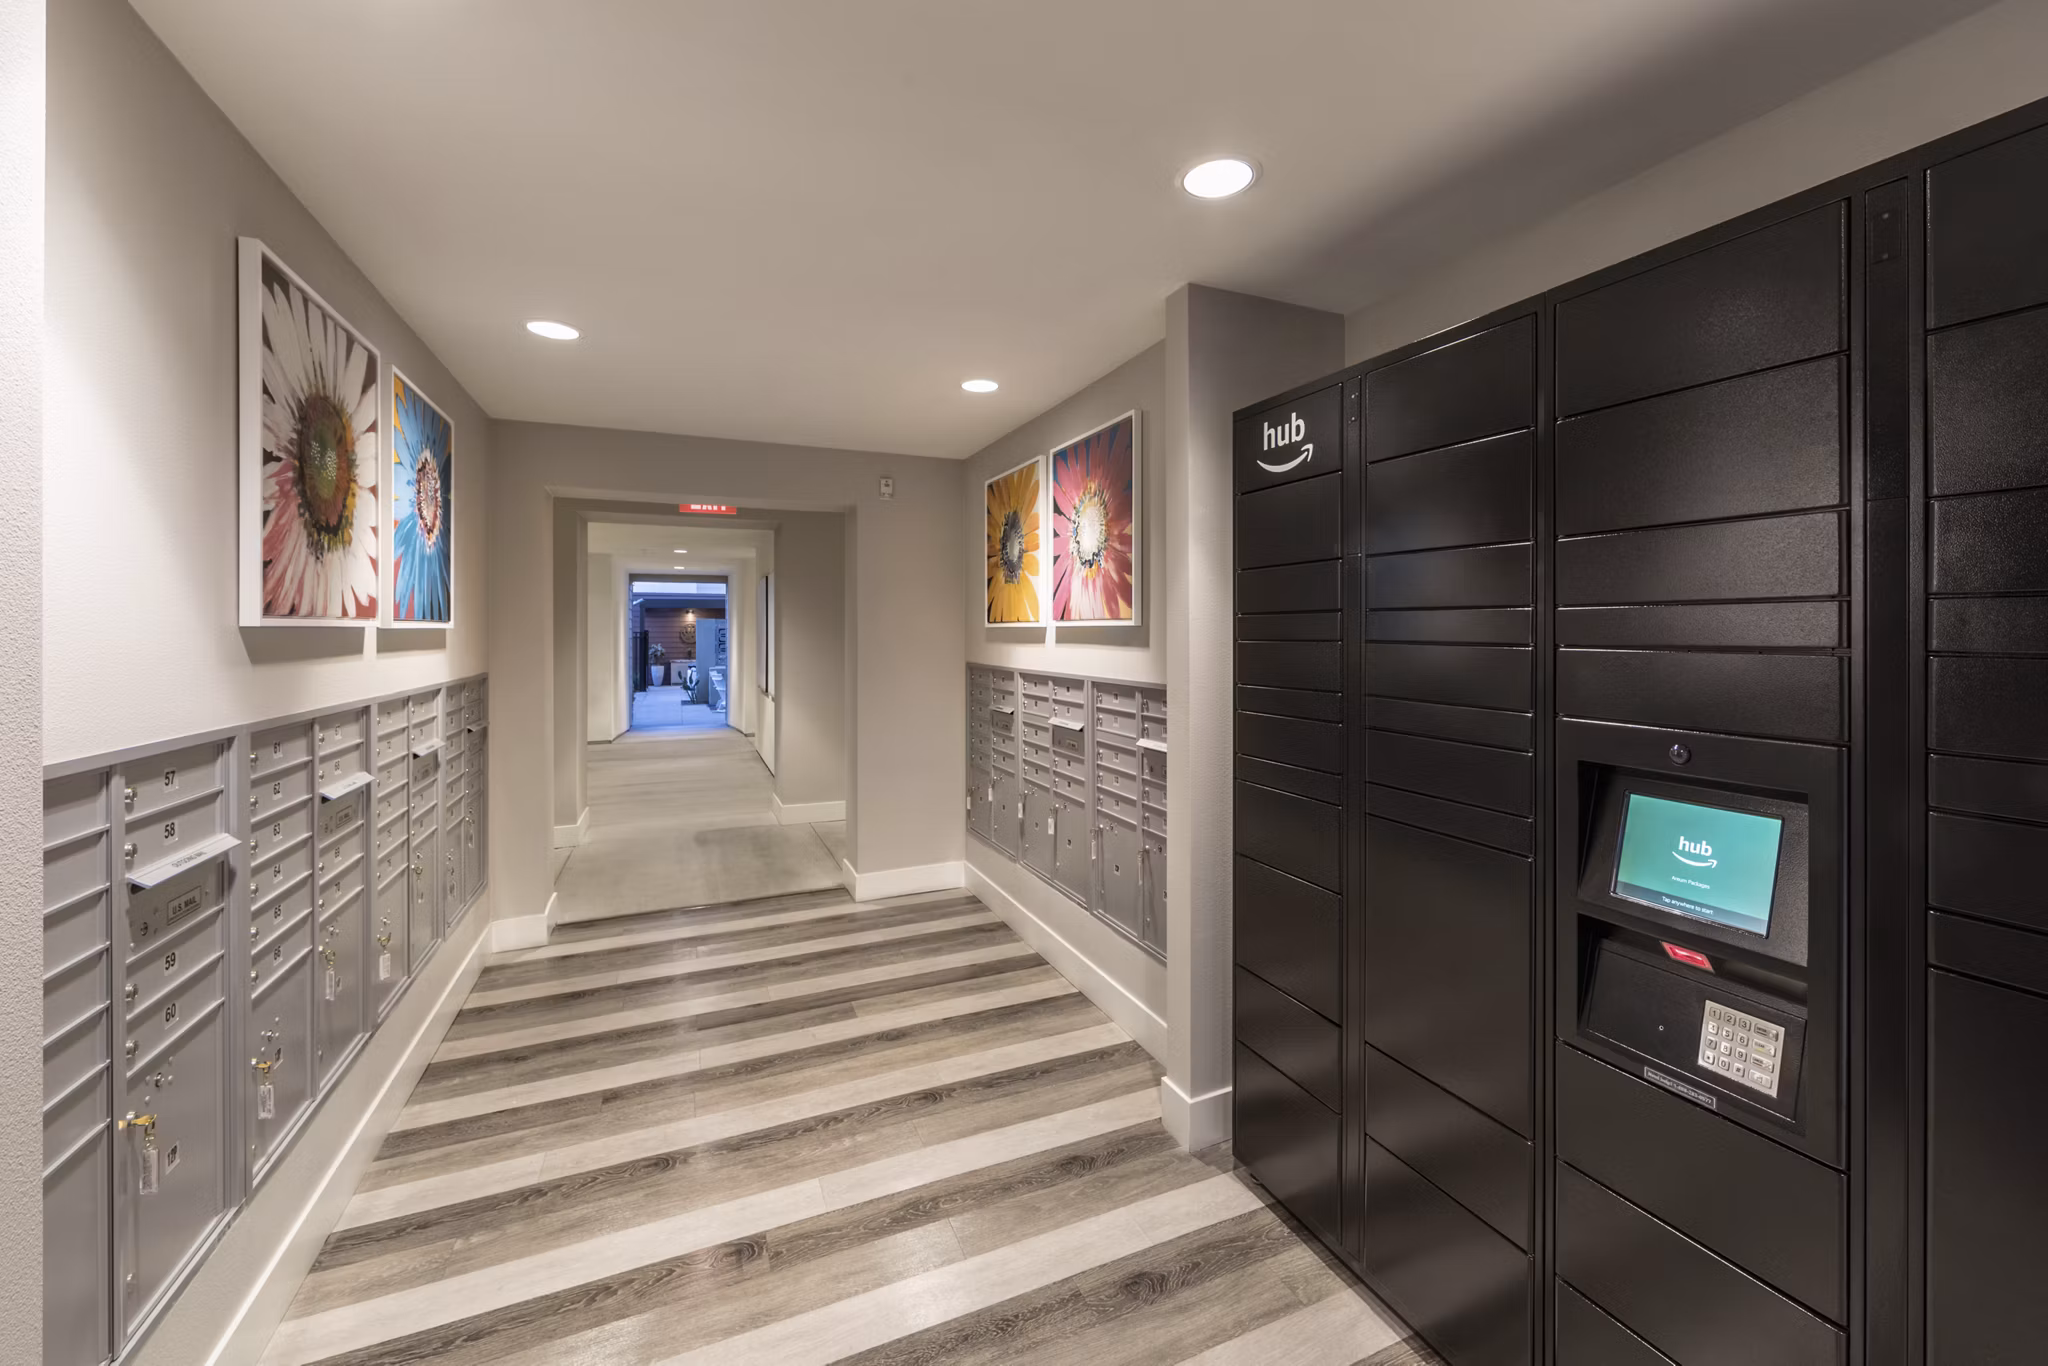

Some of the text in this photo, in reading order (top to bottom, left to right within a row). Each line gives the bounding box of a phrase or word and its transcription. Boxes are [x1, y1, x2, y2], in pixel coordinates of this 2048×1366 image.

[1263, 412, 1306, 451] hub
[273, 740, 281, 754] 61
[164, 770, 176, 786] 57
[273, 781, 281, 796] 62
[164, 821, 176, 839] 58
[273, 822, 281, 837] 63
[1678, 836, 1713, 857] hub
[273, 863, 281, 878] 64
[1687, 880, 1710, 889] Packages
[184, 896, 197, 908] MAIL
[1671, 900, 1694, 909] anywhere
[274, 904, 281, 919] 65
[165, 951, 176, 971] 59
[165, 1002, 176, 1022] 60
[1726, 1015, 1732, 1023] 2
[1741, 1020, 1747, 1029] 3
